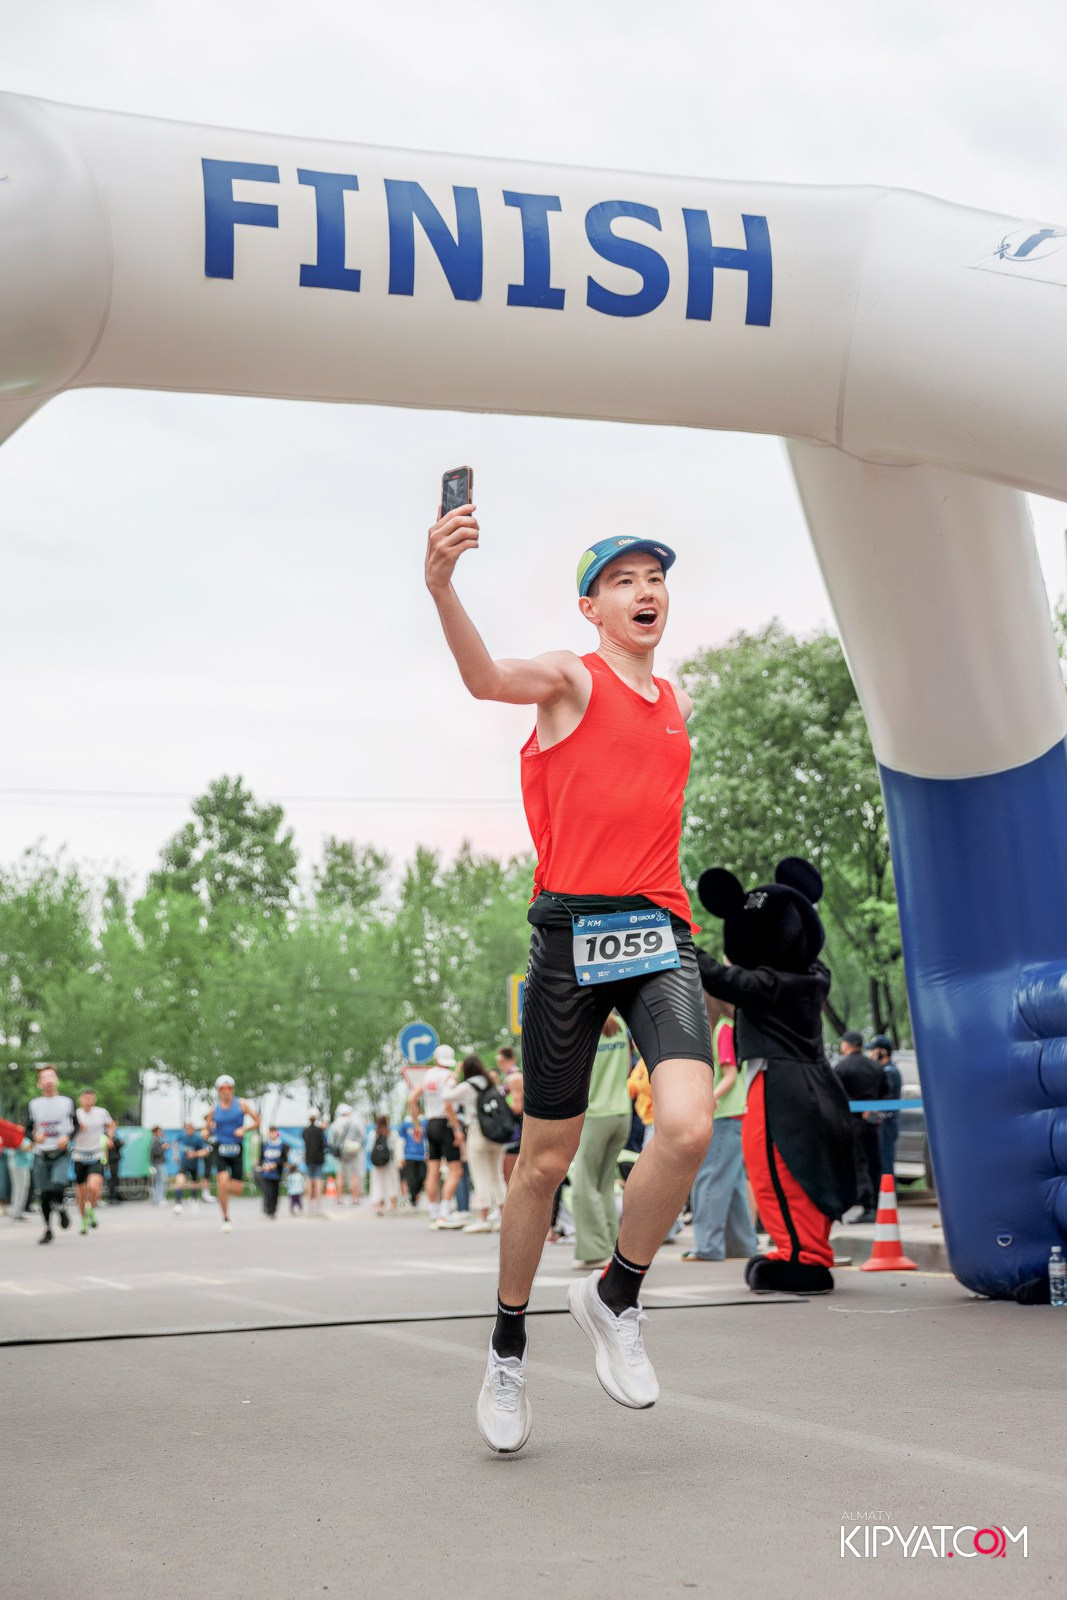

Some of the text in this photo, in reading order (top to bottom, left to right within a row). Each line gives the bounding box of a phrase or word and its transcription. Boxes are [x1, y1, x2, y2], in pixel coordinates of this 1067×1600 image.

[201, 158, 773, 327] FINISH
[578, 919, 585, 927] 5
[586, 931, 663, 962] 1059
